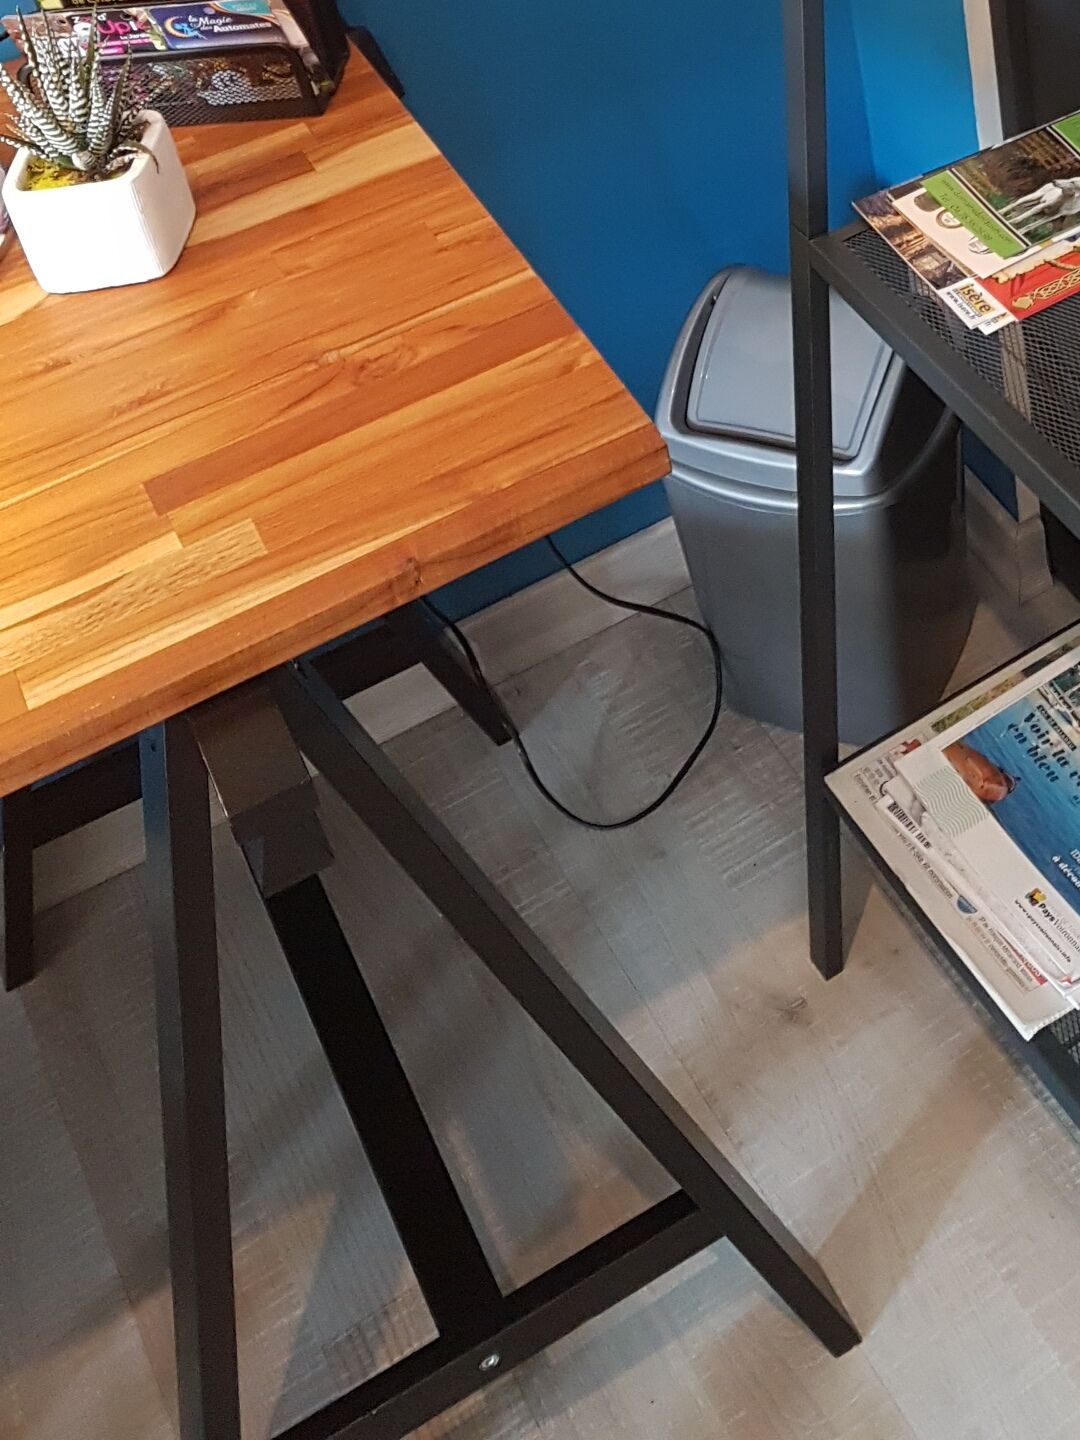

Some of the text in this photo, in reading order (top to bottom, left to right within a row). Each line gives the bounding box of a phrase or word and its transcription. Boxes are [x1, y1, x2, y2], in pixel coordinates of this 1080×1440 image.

[197, 16, 233, 28] Magie
[213, 21, 272, 33] Automates
[959, 281, 992, 316] isère
[1024, 712, 1054, 747] Voir
[1052, 748, 1070, 769] la
[1008, 722, 1060, 784] en bleu
[1051, 855, 1061, 865] à
[1038, 903, 1056, 923] Pays
